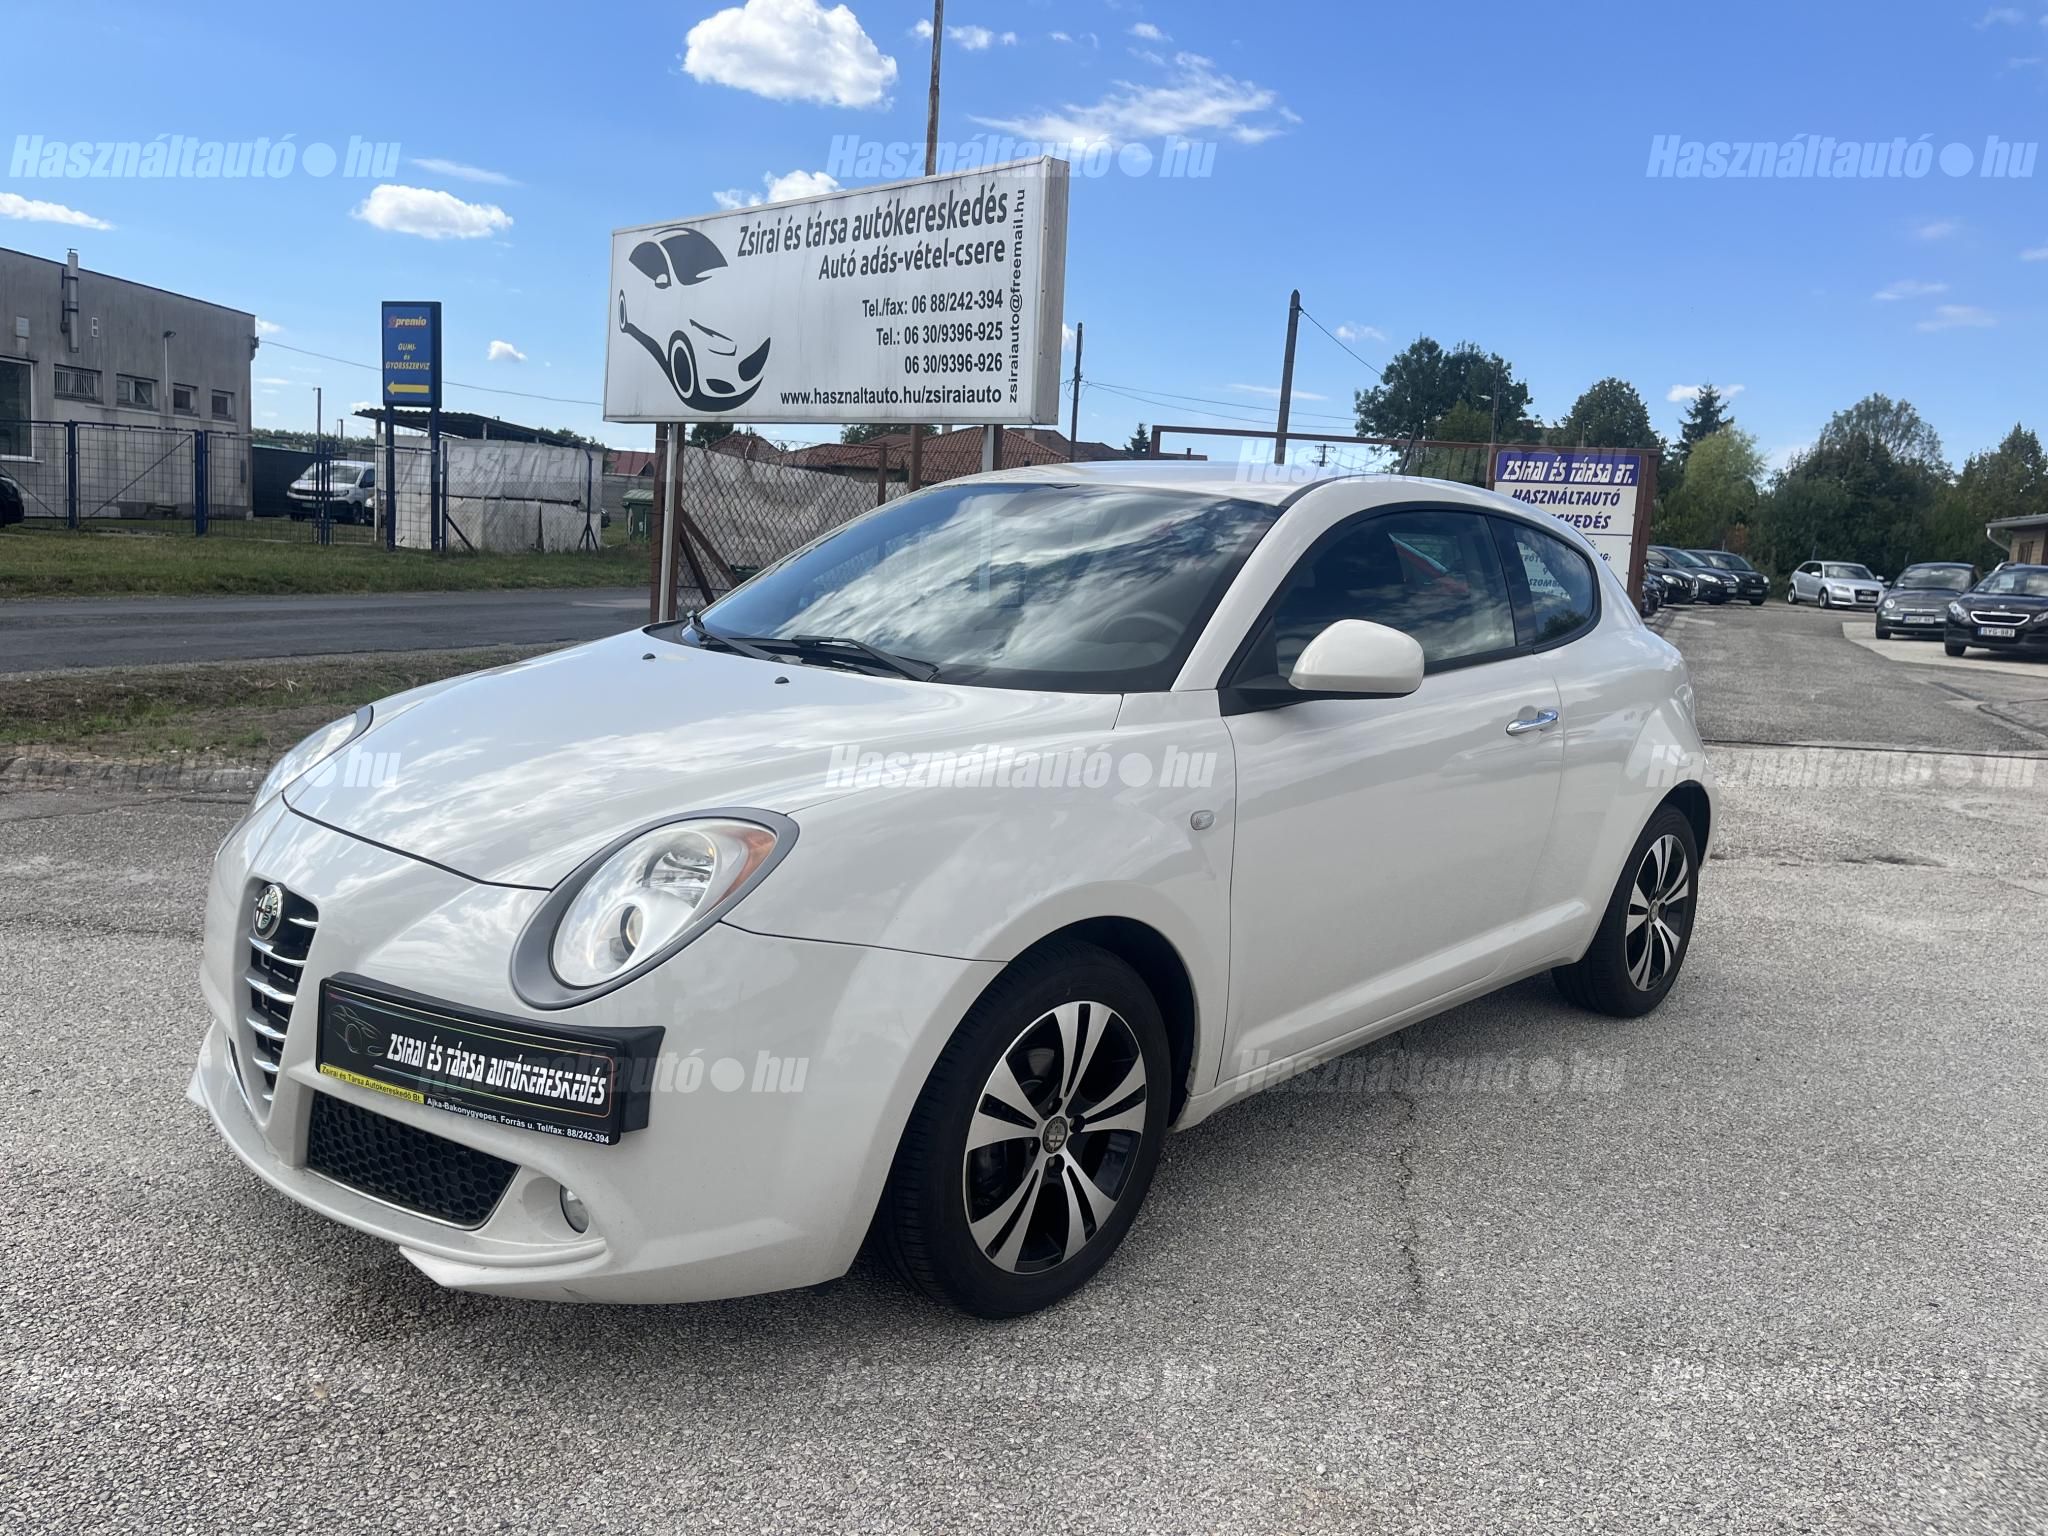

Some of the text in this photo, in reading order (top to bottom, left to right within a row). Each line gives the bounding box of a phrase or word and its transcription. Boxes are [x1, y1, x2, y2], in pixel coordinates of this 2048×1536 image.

[737, 182, 1008, 257] Zsirai és társa autókereskedés
[818, 237, 1005, 280] Autó adás-vétel-csere
[862, 289, 1003, 318] Tel./fax: 06 88/242-394
[1008, 189, 1025, 403] zsiraiauto@freemail.hu
[395, 316, 427, 328] premio
[876, 321, 1003, 346] Tel.: 06 30/9396-925
[904, 352, 1003, 374] 06 30/9396-926
[780, 385, 1002, 406] www.hasznaltauto.hu/zsiraiauto
[1502, 455, 1635, 484] ZSIRAI ÉS TÁRSA BT.
[1511, 487, 1621, 507] HASZNÁLTAUTÓ
[387, 1033, 606, 1106] ZSIRAI ÉS TÁRSA AUTÓKERESKEDÉS
[427, 1098, 499, 1123] Ajka-Bakonygyepes,
[500, 1115, 525, 1129] Forrás
[567, 1128, 609, 1144] 88/242-394
